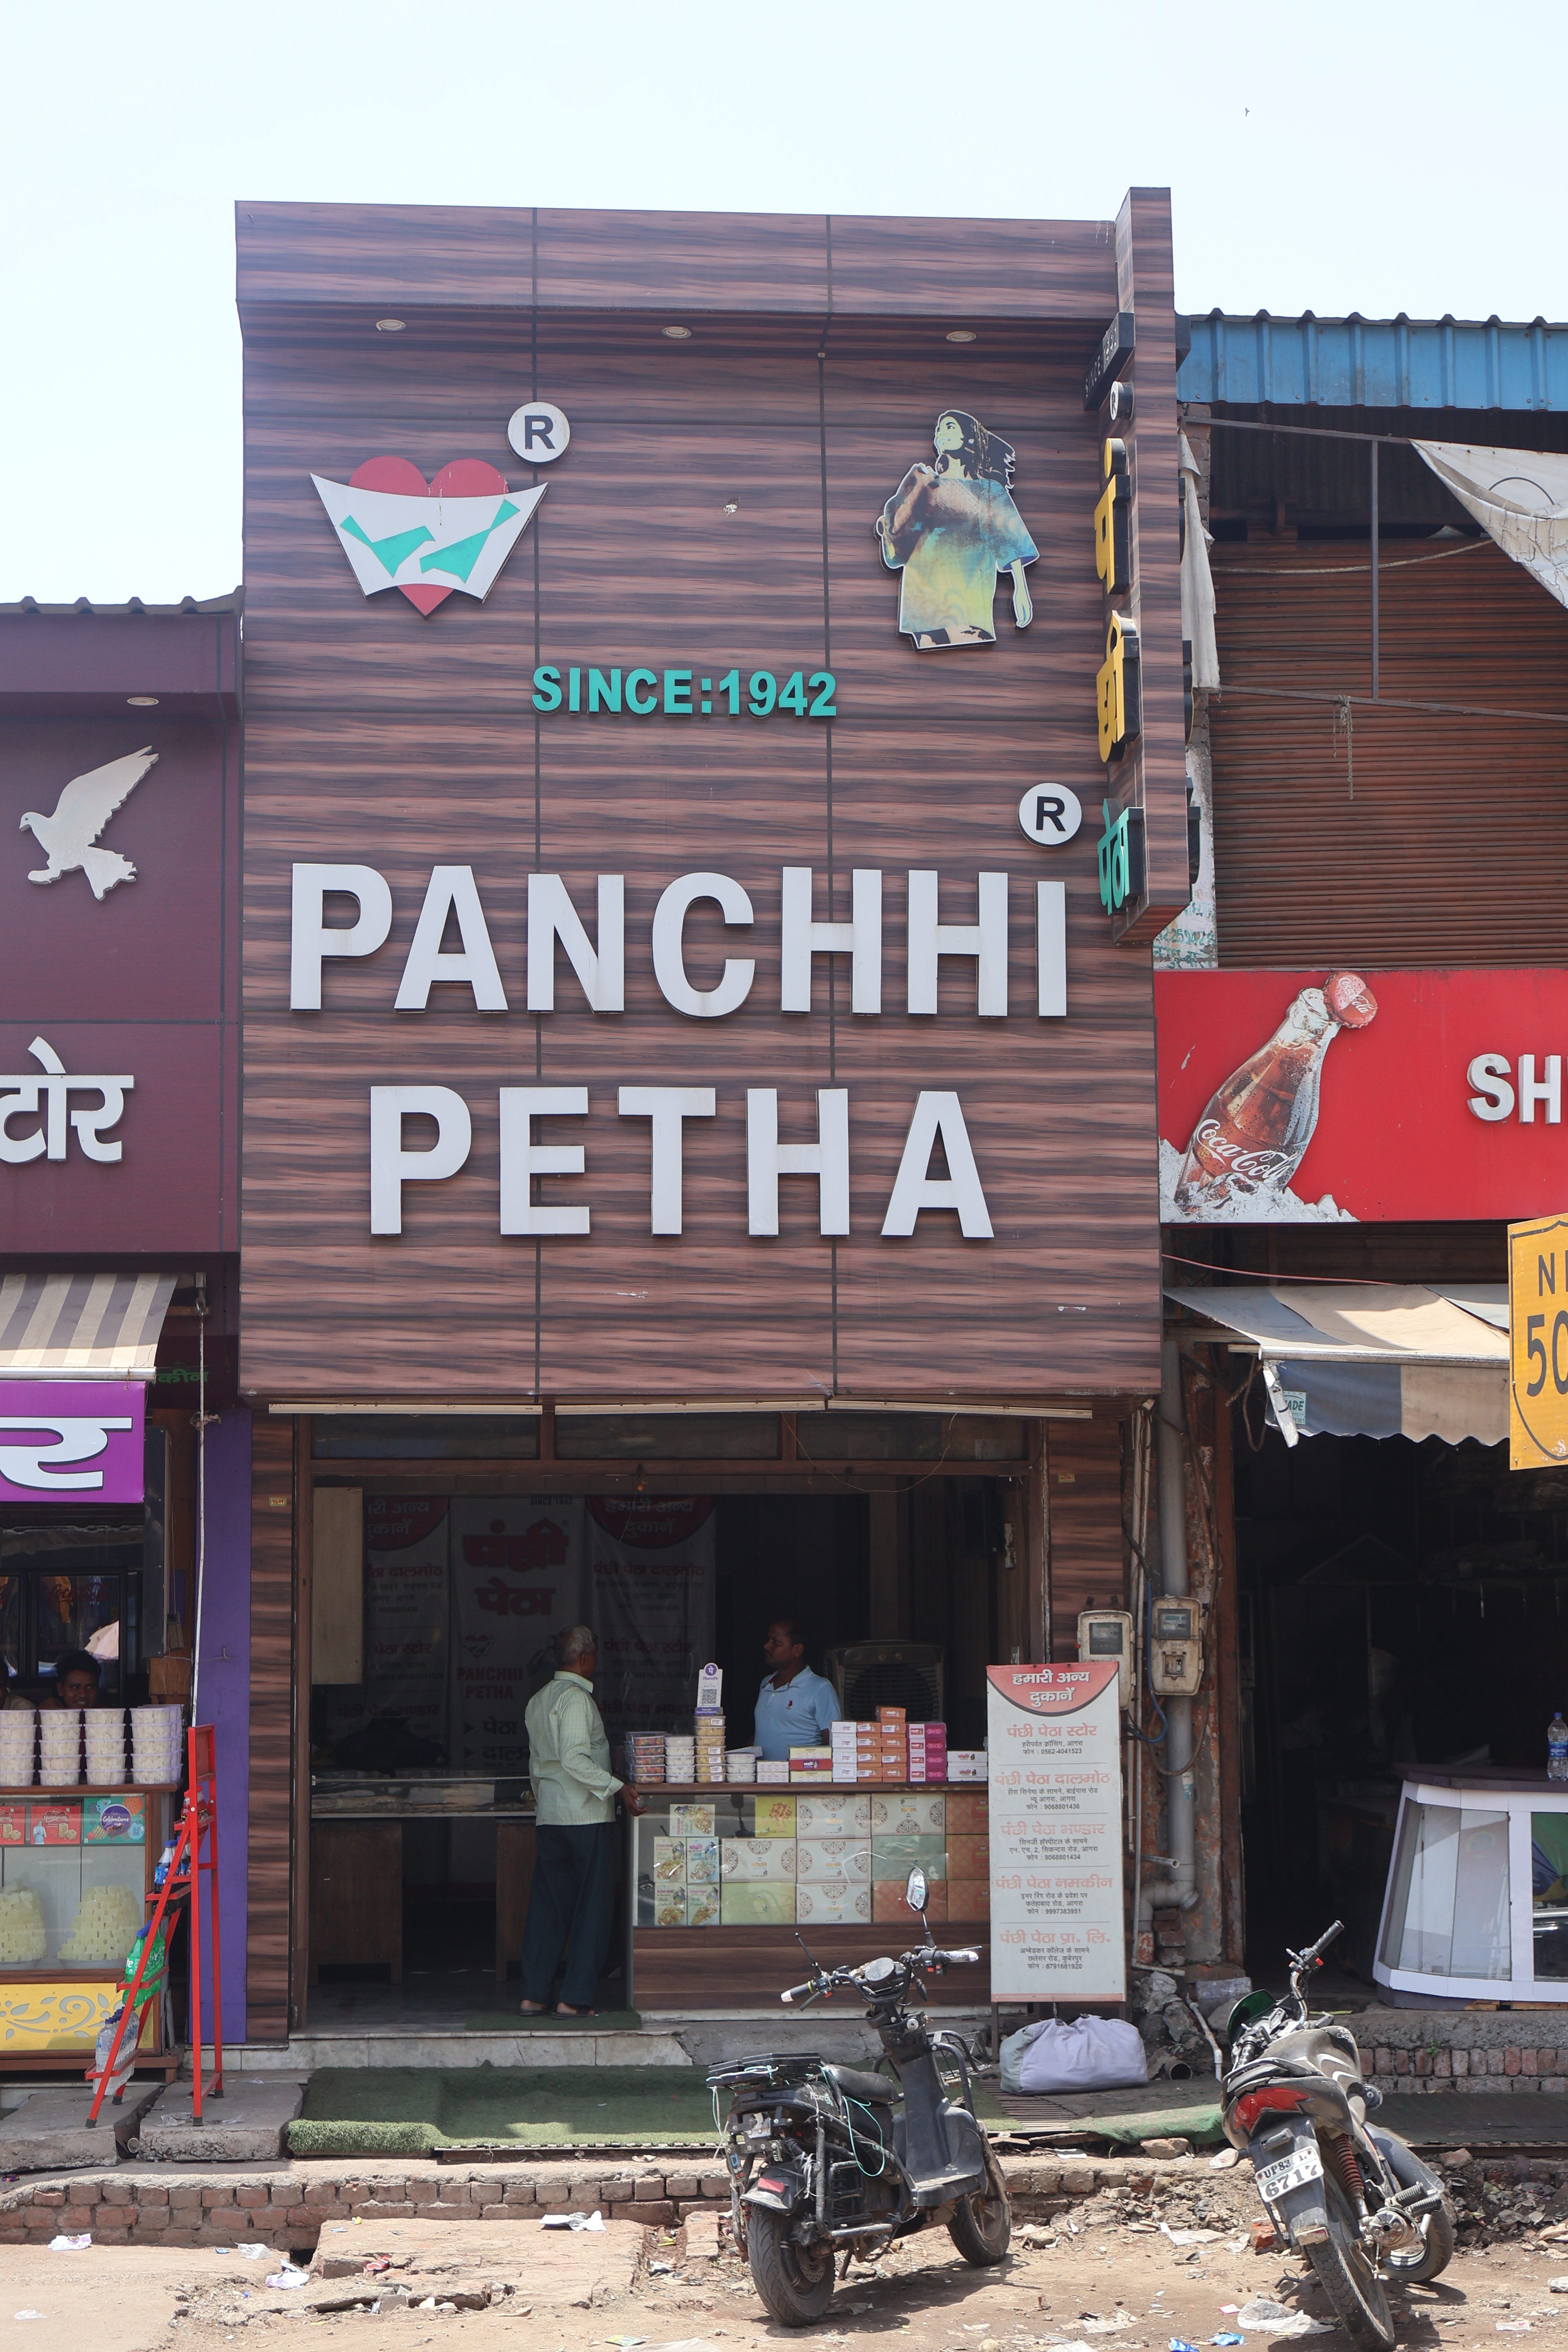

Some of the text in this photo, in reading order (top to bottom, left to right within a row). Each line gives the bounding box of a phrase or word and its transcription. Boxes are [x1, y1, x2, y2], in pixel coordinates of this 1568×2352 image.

[532, 665, 837, 717] SINCE:1942
[1098, 798, 1129, 915] पेठा
[291, 863, 1066, 1018] PANCHHI
[1466, 1053, 1568, 1124] SH
[370, 1085, 994, 1238] PETHA
[1538, 1250, 1568, 1296] N
[1285, 1400, 1304, 1411] ADE
[530, 1497, 573, 1505] SINCE 1942
[605, 1497, 694, 1513] हमारी अन्य
[625, 1517, 677, 1539] दुकानें
[463, 1517, 569, 1572] पंछी
[594, 1560, 619, 1575] पंछी
[624, 1562, 647, 1575] पेठा
[475, 1576, 556, 1616] पेठा
[456, 1667, 523, 1681] PANCHHI
[1012, 1669, 1090, 1685] हमारी अन्य
[465, 1685, 514, 1699] PETHA
[1029, 1687, 1076, 1707] दुकानें
[482, 1716, 518, 1735] पेठा
[1006, 1722, 1098, 1738] पंछी पेठा स्टोर
[995, 1769, 1111, 1785] पंछी पेठा दालमोठ
[1000, 1821, 1106, 1835] पंछी पेठा भण्डार
[995, 1873, 1113, 1889] पंछी पेठा नमकीन
[1000, 1928, 1111, 1945] पंछी पेठा प्रा. लि.
[1263, 2159, 1291, 2178] UP83
[1265, 2164, 1318, 2198] 6717
